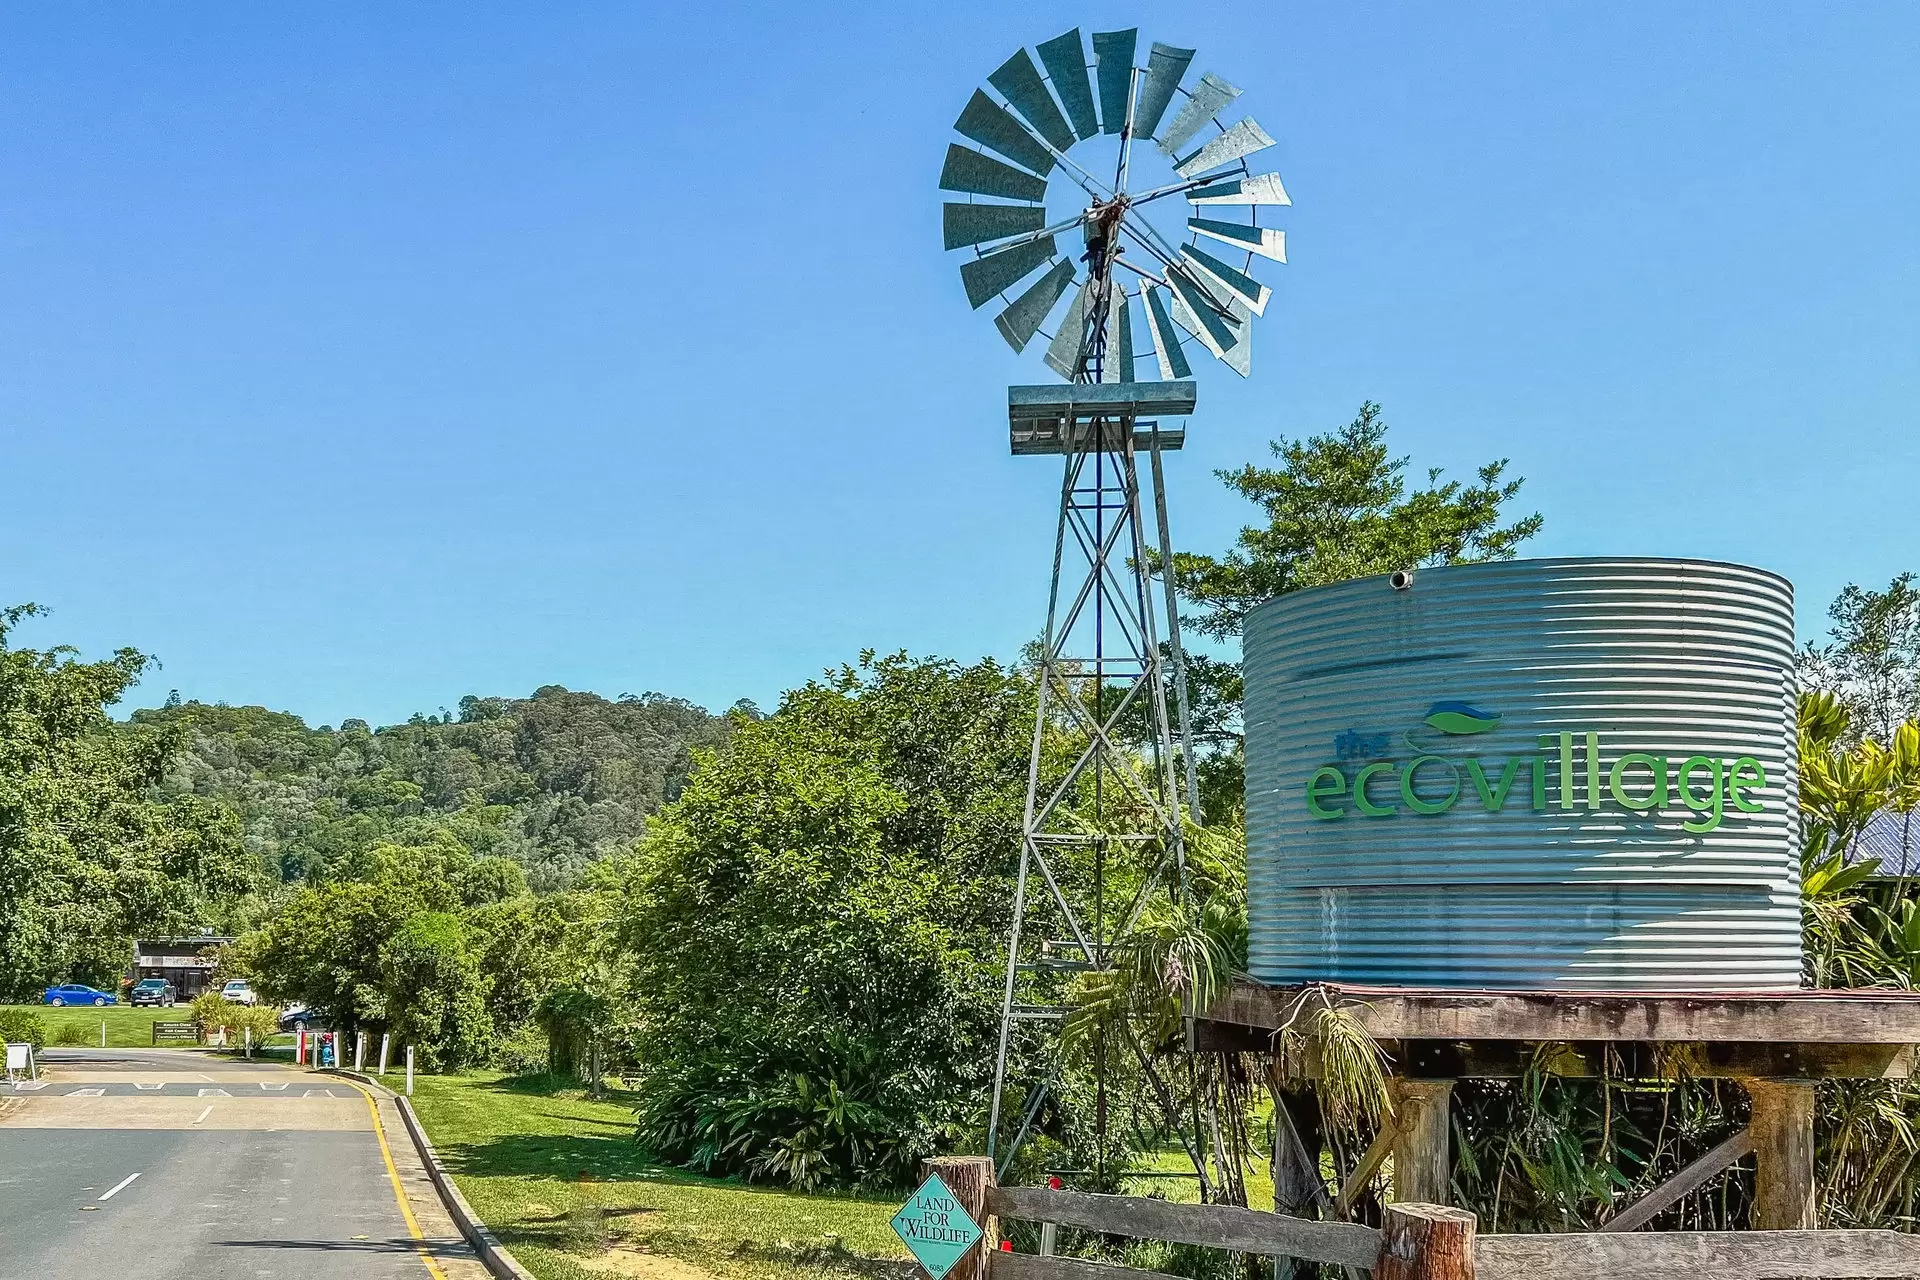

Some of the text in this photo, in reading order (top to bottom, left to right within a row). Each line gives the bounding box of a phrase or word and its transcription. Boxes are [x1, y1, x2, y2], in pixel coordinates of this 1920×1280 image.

[1334, 728, 1391, 758] the
[1305, 731, 1766, 834] ecovillage
[916, 1195, 955, 1212] LAND
[900, 1217, 971, 1244] WILDLIFE
[923, 1211, 950, 1227] FOR
